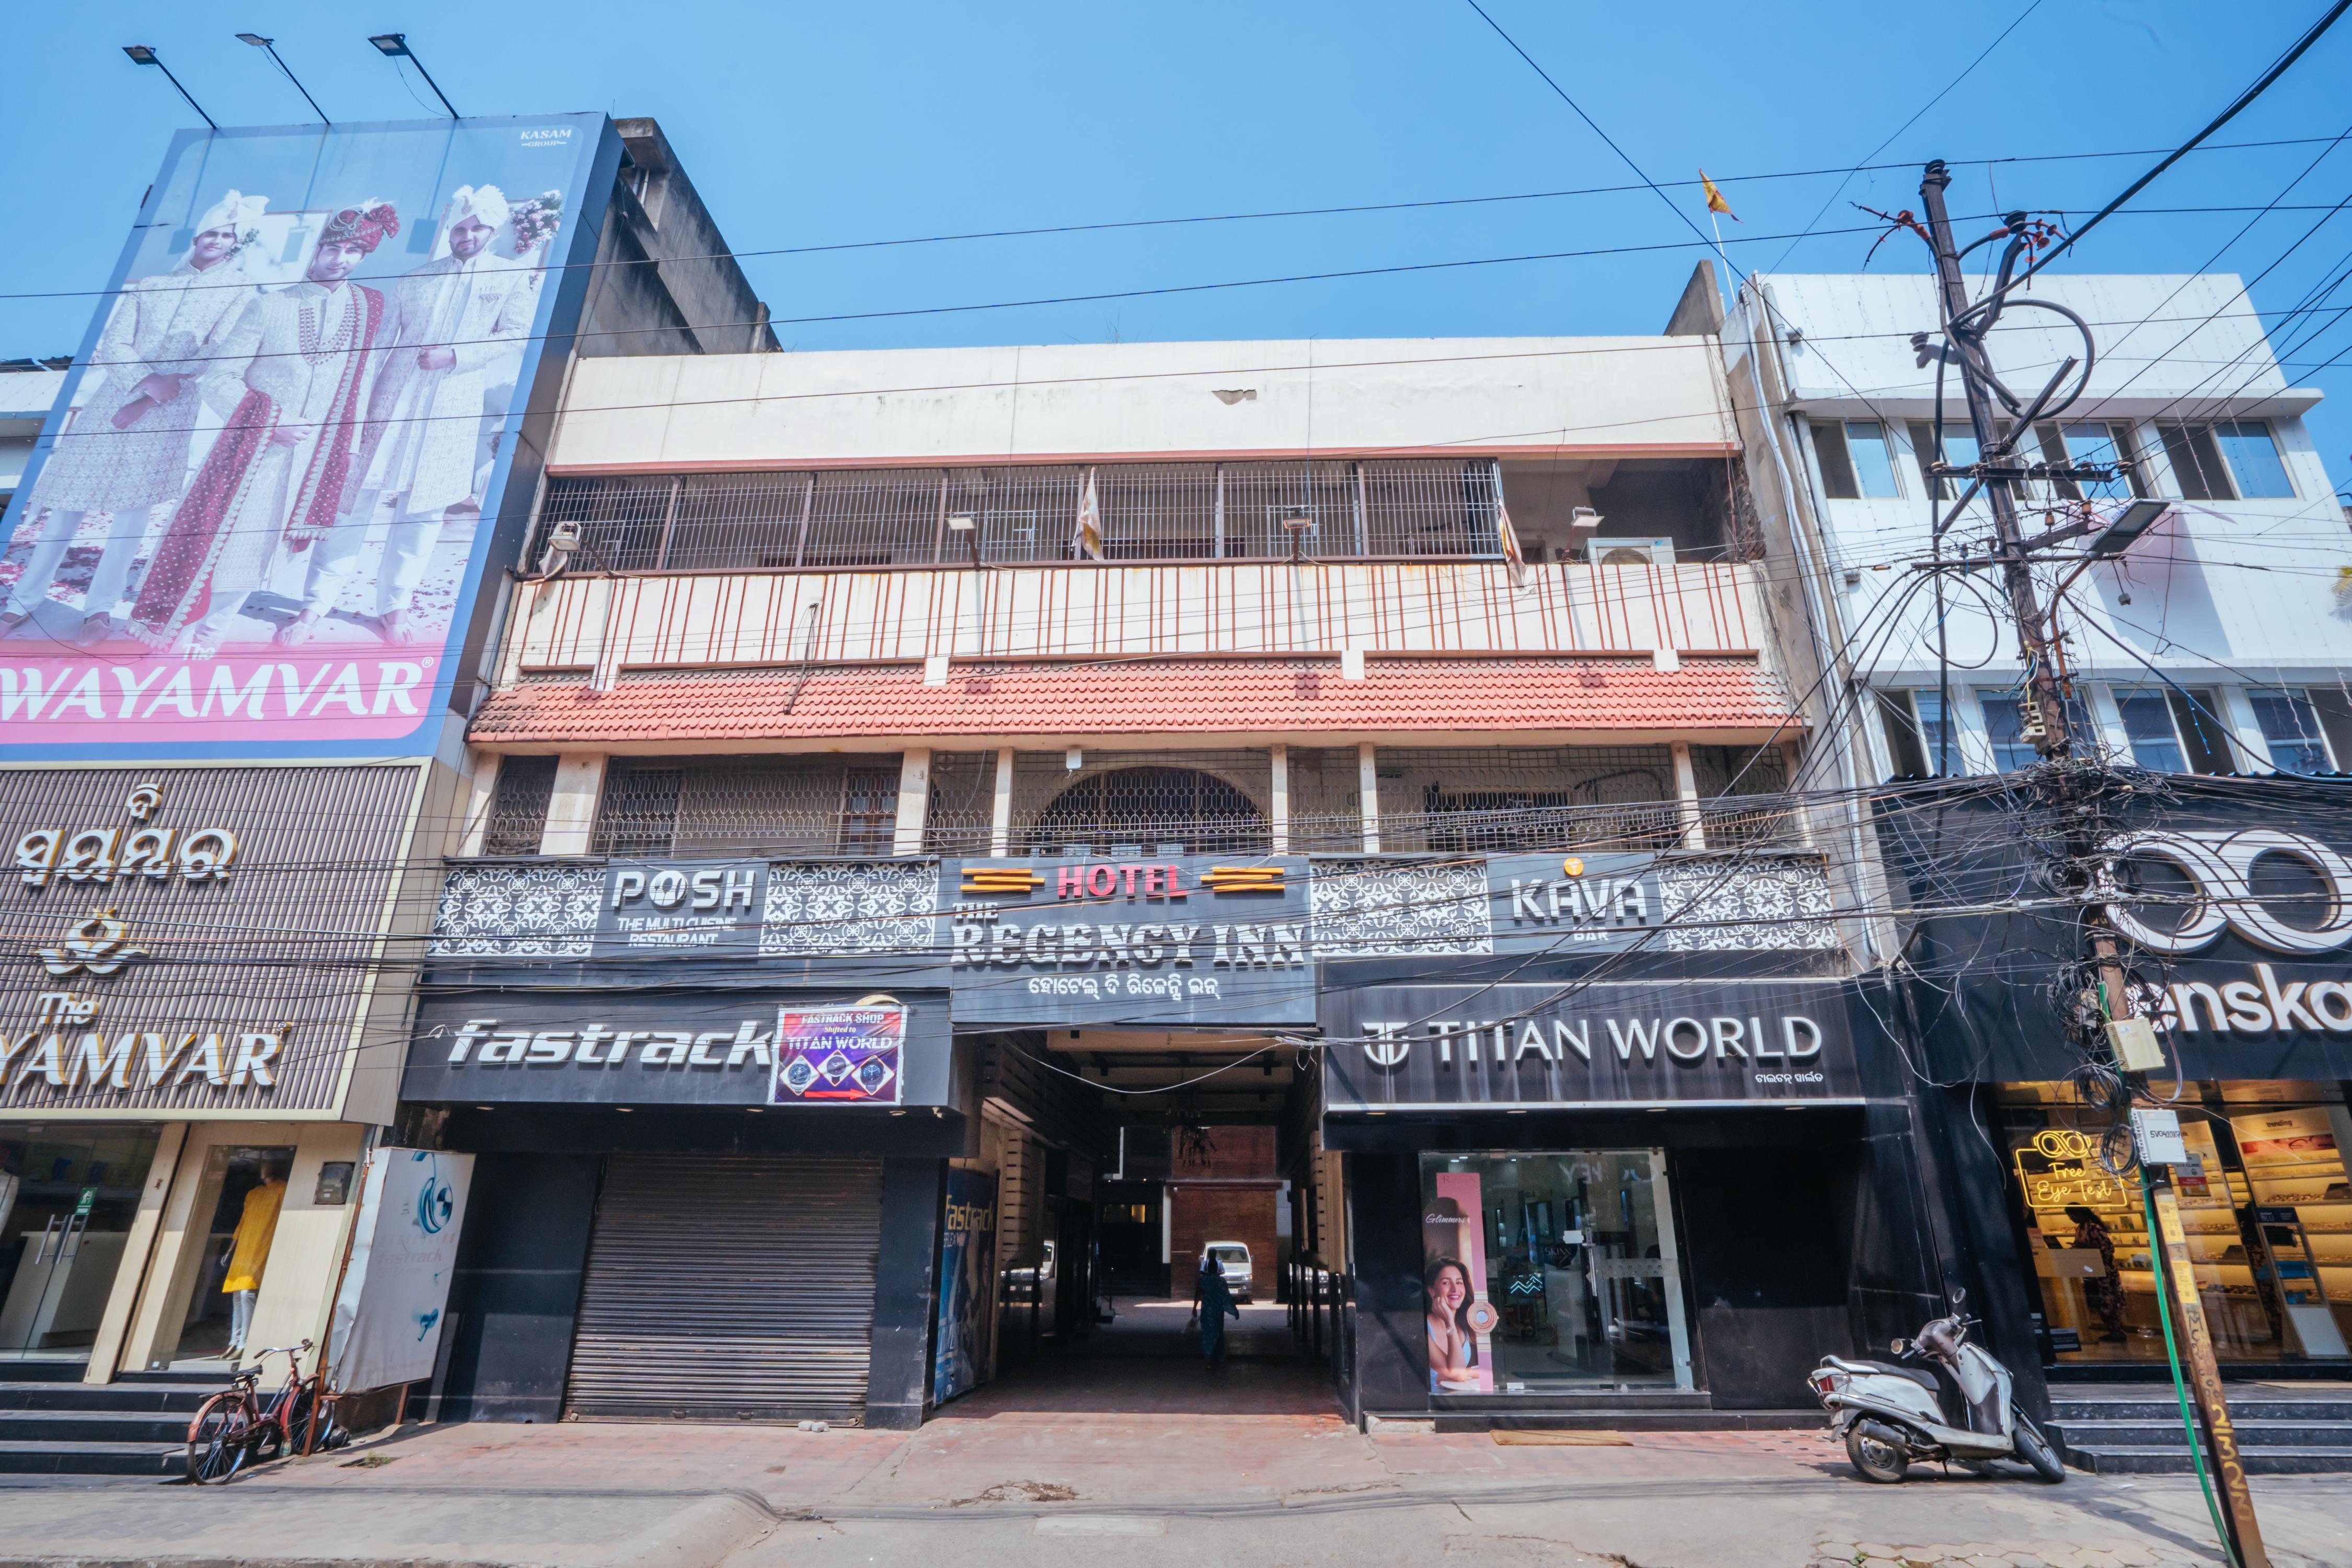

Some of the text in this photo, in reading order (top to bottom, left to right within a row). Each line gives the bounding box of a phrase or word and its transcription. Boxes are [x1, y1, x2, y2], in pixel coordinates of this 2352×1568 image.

[521, 129, 572, 140] KASAM
[183, 643, 215, 660] The
[611, 870, 755, 907] POSH
[1057, 864, 1187, 897] HOTEL
[1511, 879, 1647, 918] KAVA
[953, 902, 999, 919] THE
[618, 918, 644, 931] THE
[685, 917, 737, 931] CUISINE
[628, 933, 718, 947] RESTAURANT
[1573, 927, 1609, 941] BAR
[950, 924, 1305, 963] REGENCY INN
[38, 993, 100, 1025] The
[801, 1013, 885, 1024] FASTRACK SHOP
[447, 1019, 776, 1066] fastrack
[787, 1036, 893, 1050] TITAN WORLD
[1427, 1017, 1822, 1062] TITAN WORLD
[2048, 1162, 2086, 1180] Free
[2037, 1180, 2112, 1202] Eye Test
